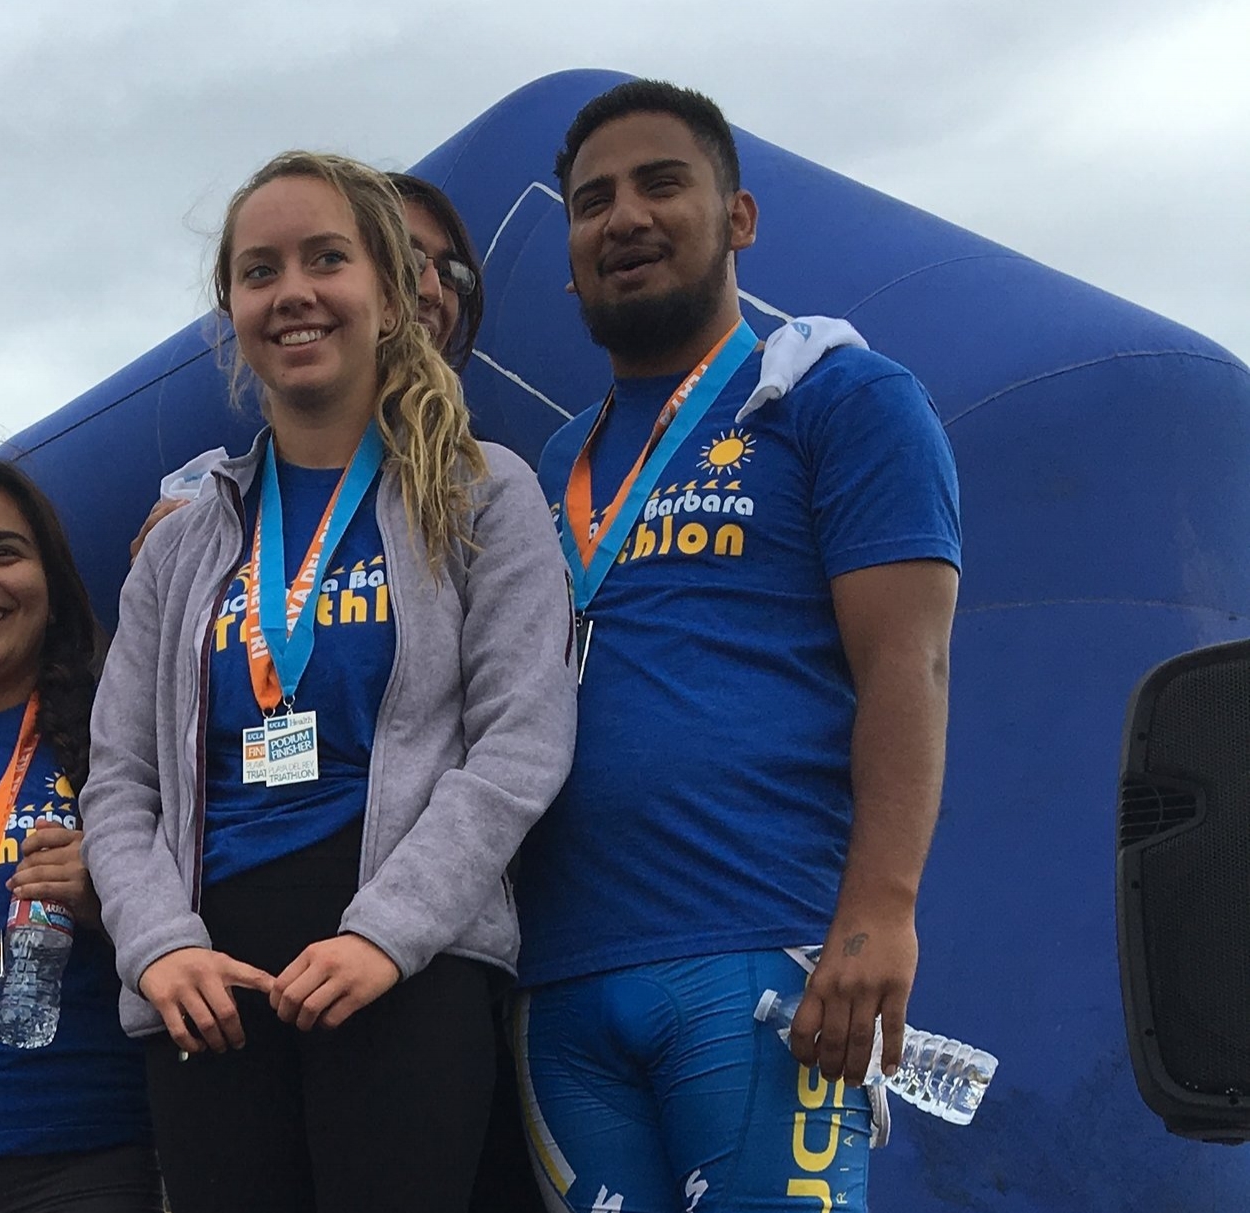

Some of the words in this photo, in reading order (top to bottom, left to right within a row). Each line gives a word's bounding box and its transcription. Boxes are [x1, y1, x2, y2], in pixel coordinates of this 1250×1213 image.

[644, 490, 754, 522] Barbara
[269, 721, 287, 729] UCLA
[247, 733, 264, 741] UCLA
[270, 731, 310, 750] PODIUM
[271, 741, 312, 760] FINISHER
[268, 766, 288, 774] PLAYA
[290, 763, 301, 771] DEL
[302, 760, 314, 769] REY
[269, 769, 315, 783] TRIATHLON
